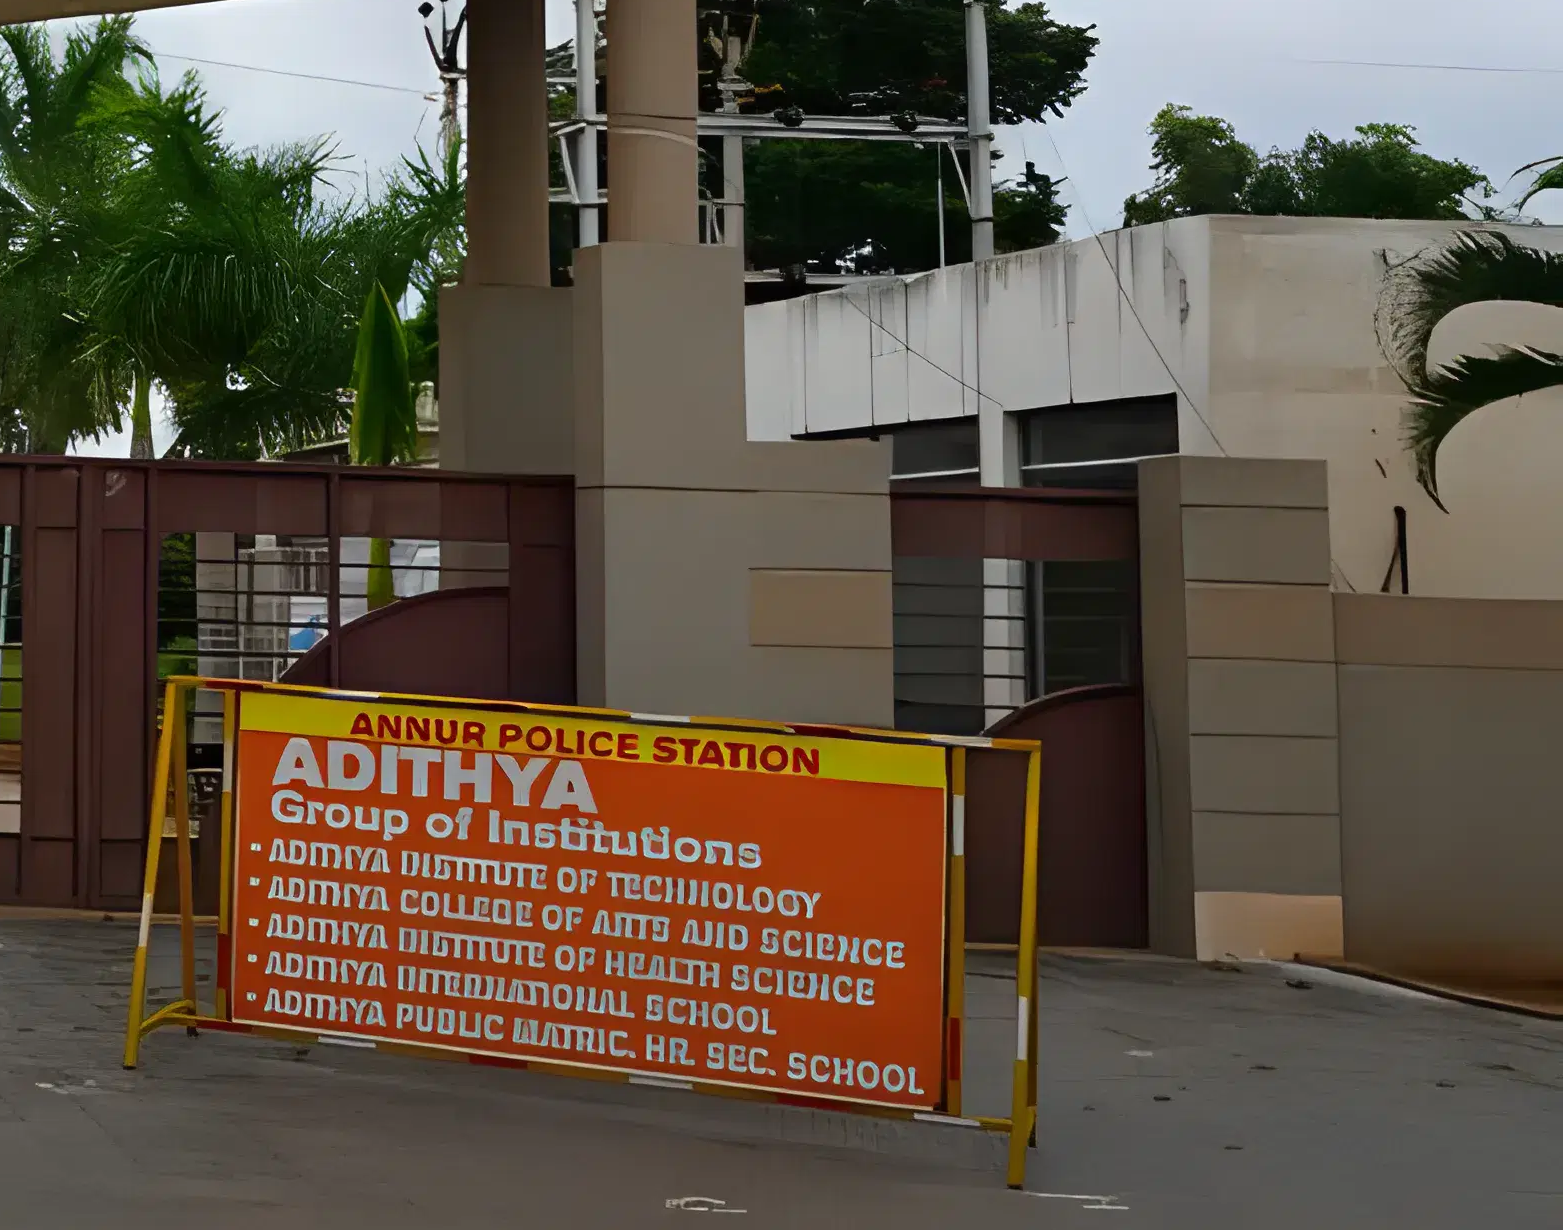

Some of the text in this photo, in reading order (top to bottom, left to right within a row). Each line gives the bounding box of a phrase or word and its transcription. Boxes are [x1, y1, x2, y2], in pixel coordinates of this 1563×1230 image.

[271, 737, 599, 814] ADITHYA
[350, 712, 820, 774] ANNUR POLICE STATION
[271, 789, 763, 869] Group of Institutions
[556, 866, 599, 895] OF
[606, 871, 822, 919] TECHNOLOGY
[400, 889, 533, 928] COLLEGE
[541, 904, 584, 932] OF
[681, 919, 749, 952] AND
[759, 927, 907, 970] SCIENCE
[554, 944, 597, 973] OF
[604, 950, 721, 989] HEALTH
[730, 964, 876, 1006] SCIENCE
[396, 1003, 505, 1041] PUBLIC
[786, 1052, 926, 1096] SCHOOL
[645, 994, 778, 1036] SCHOOL
